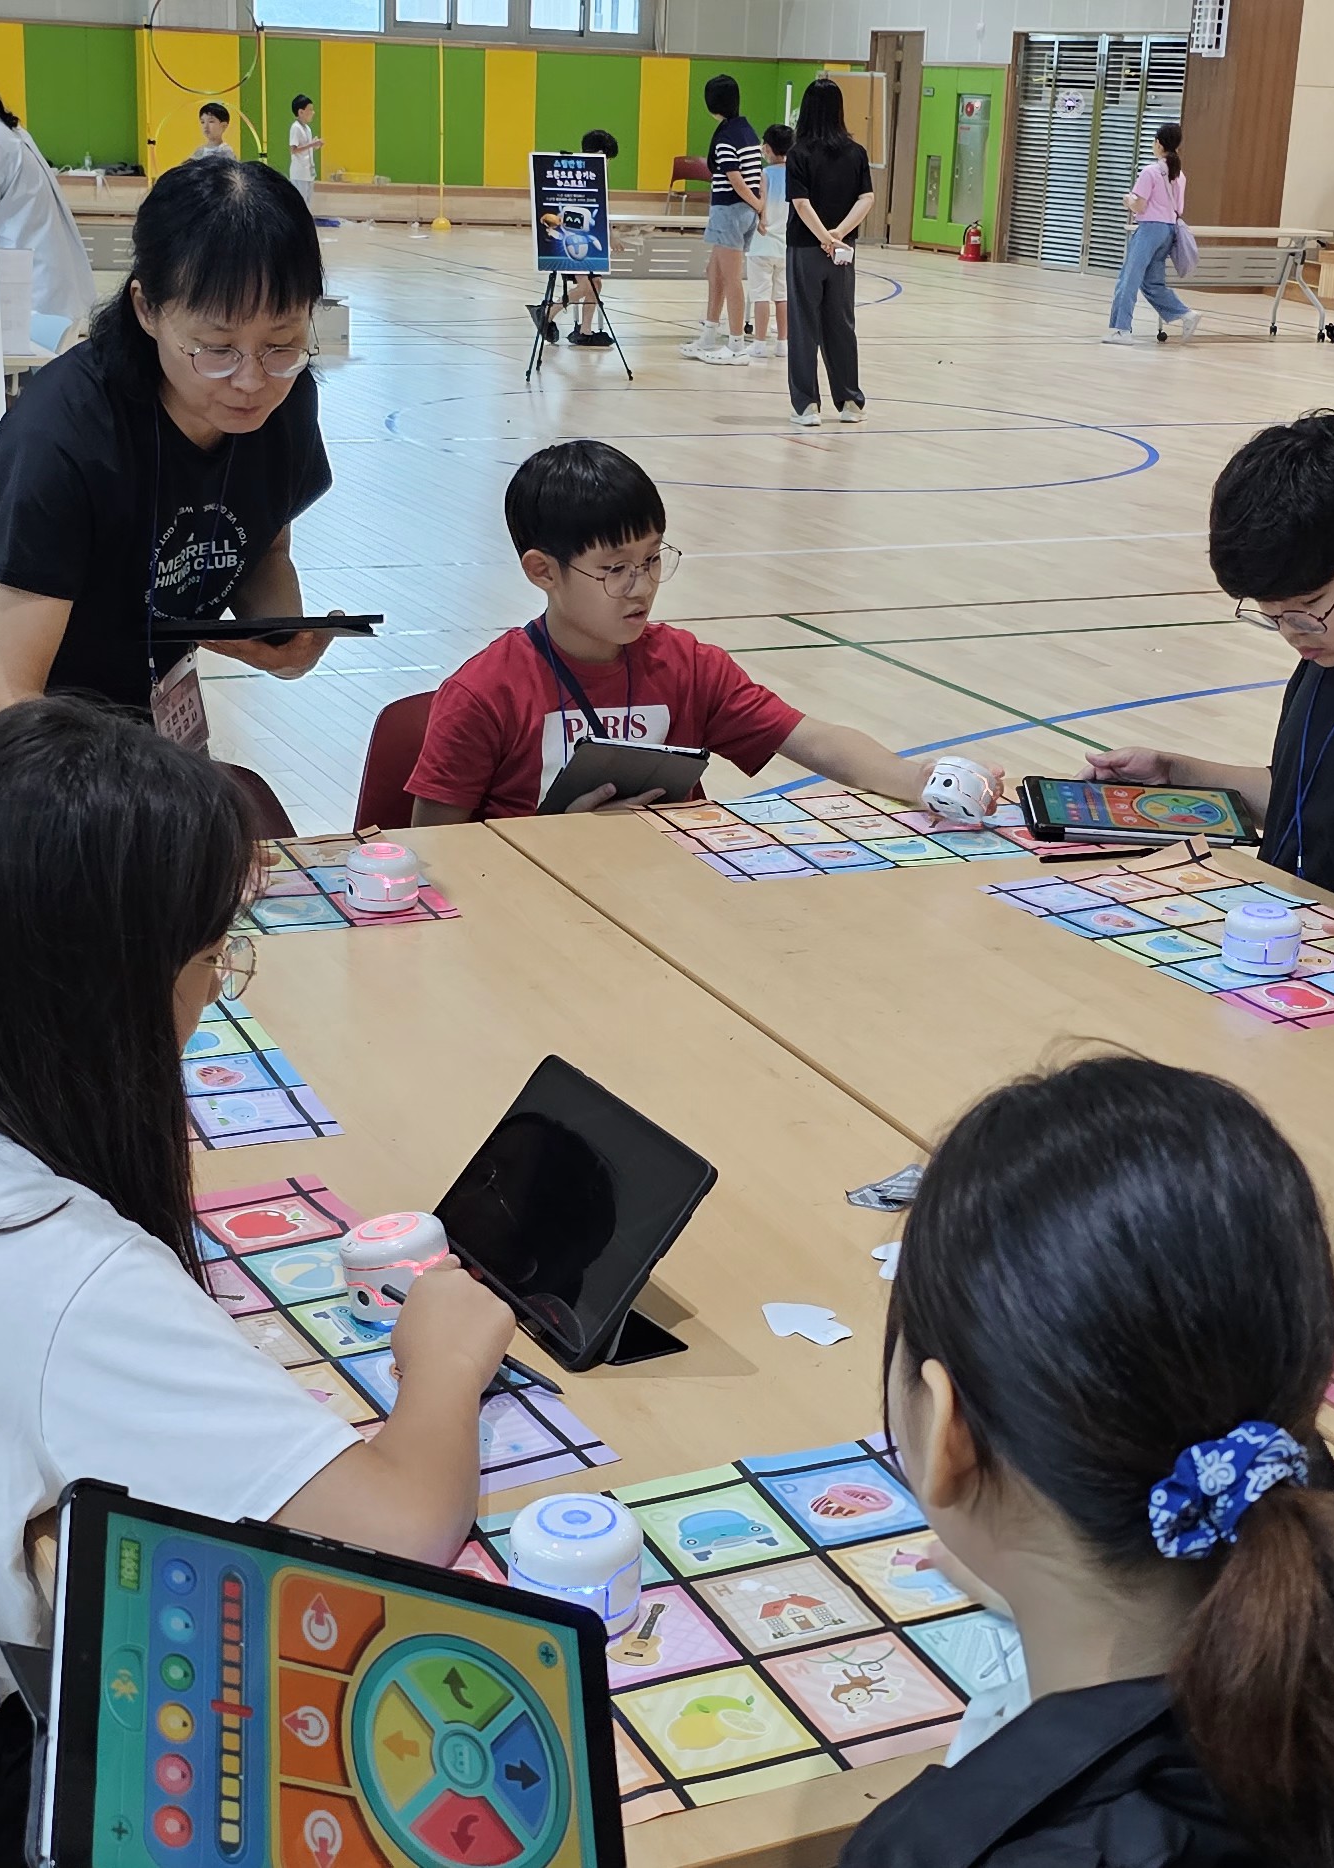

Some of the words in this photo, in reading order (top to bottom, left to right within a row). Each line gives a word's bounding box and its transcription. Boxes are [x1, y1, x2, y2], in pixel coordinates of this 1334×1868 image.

[157, 539, 238, 575] MERRELL
[193, 555, 238, 571] CLUB
[566, 713, 648, 743] PRIS
[712, 1584, 734, 1597] H
